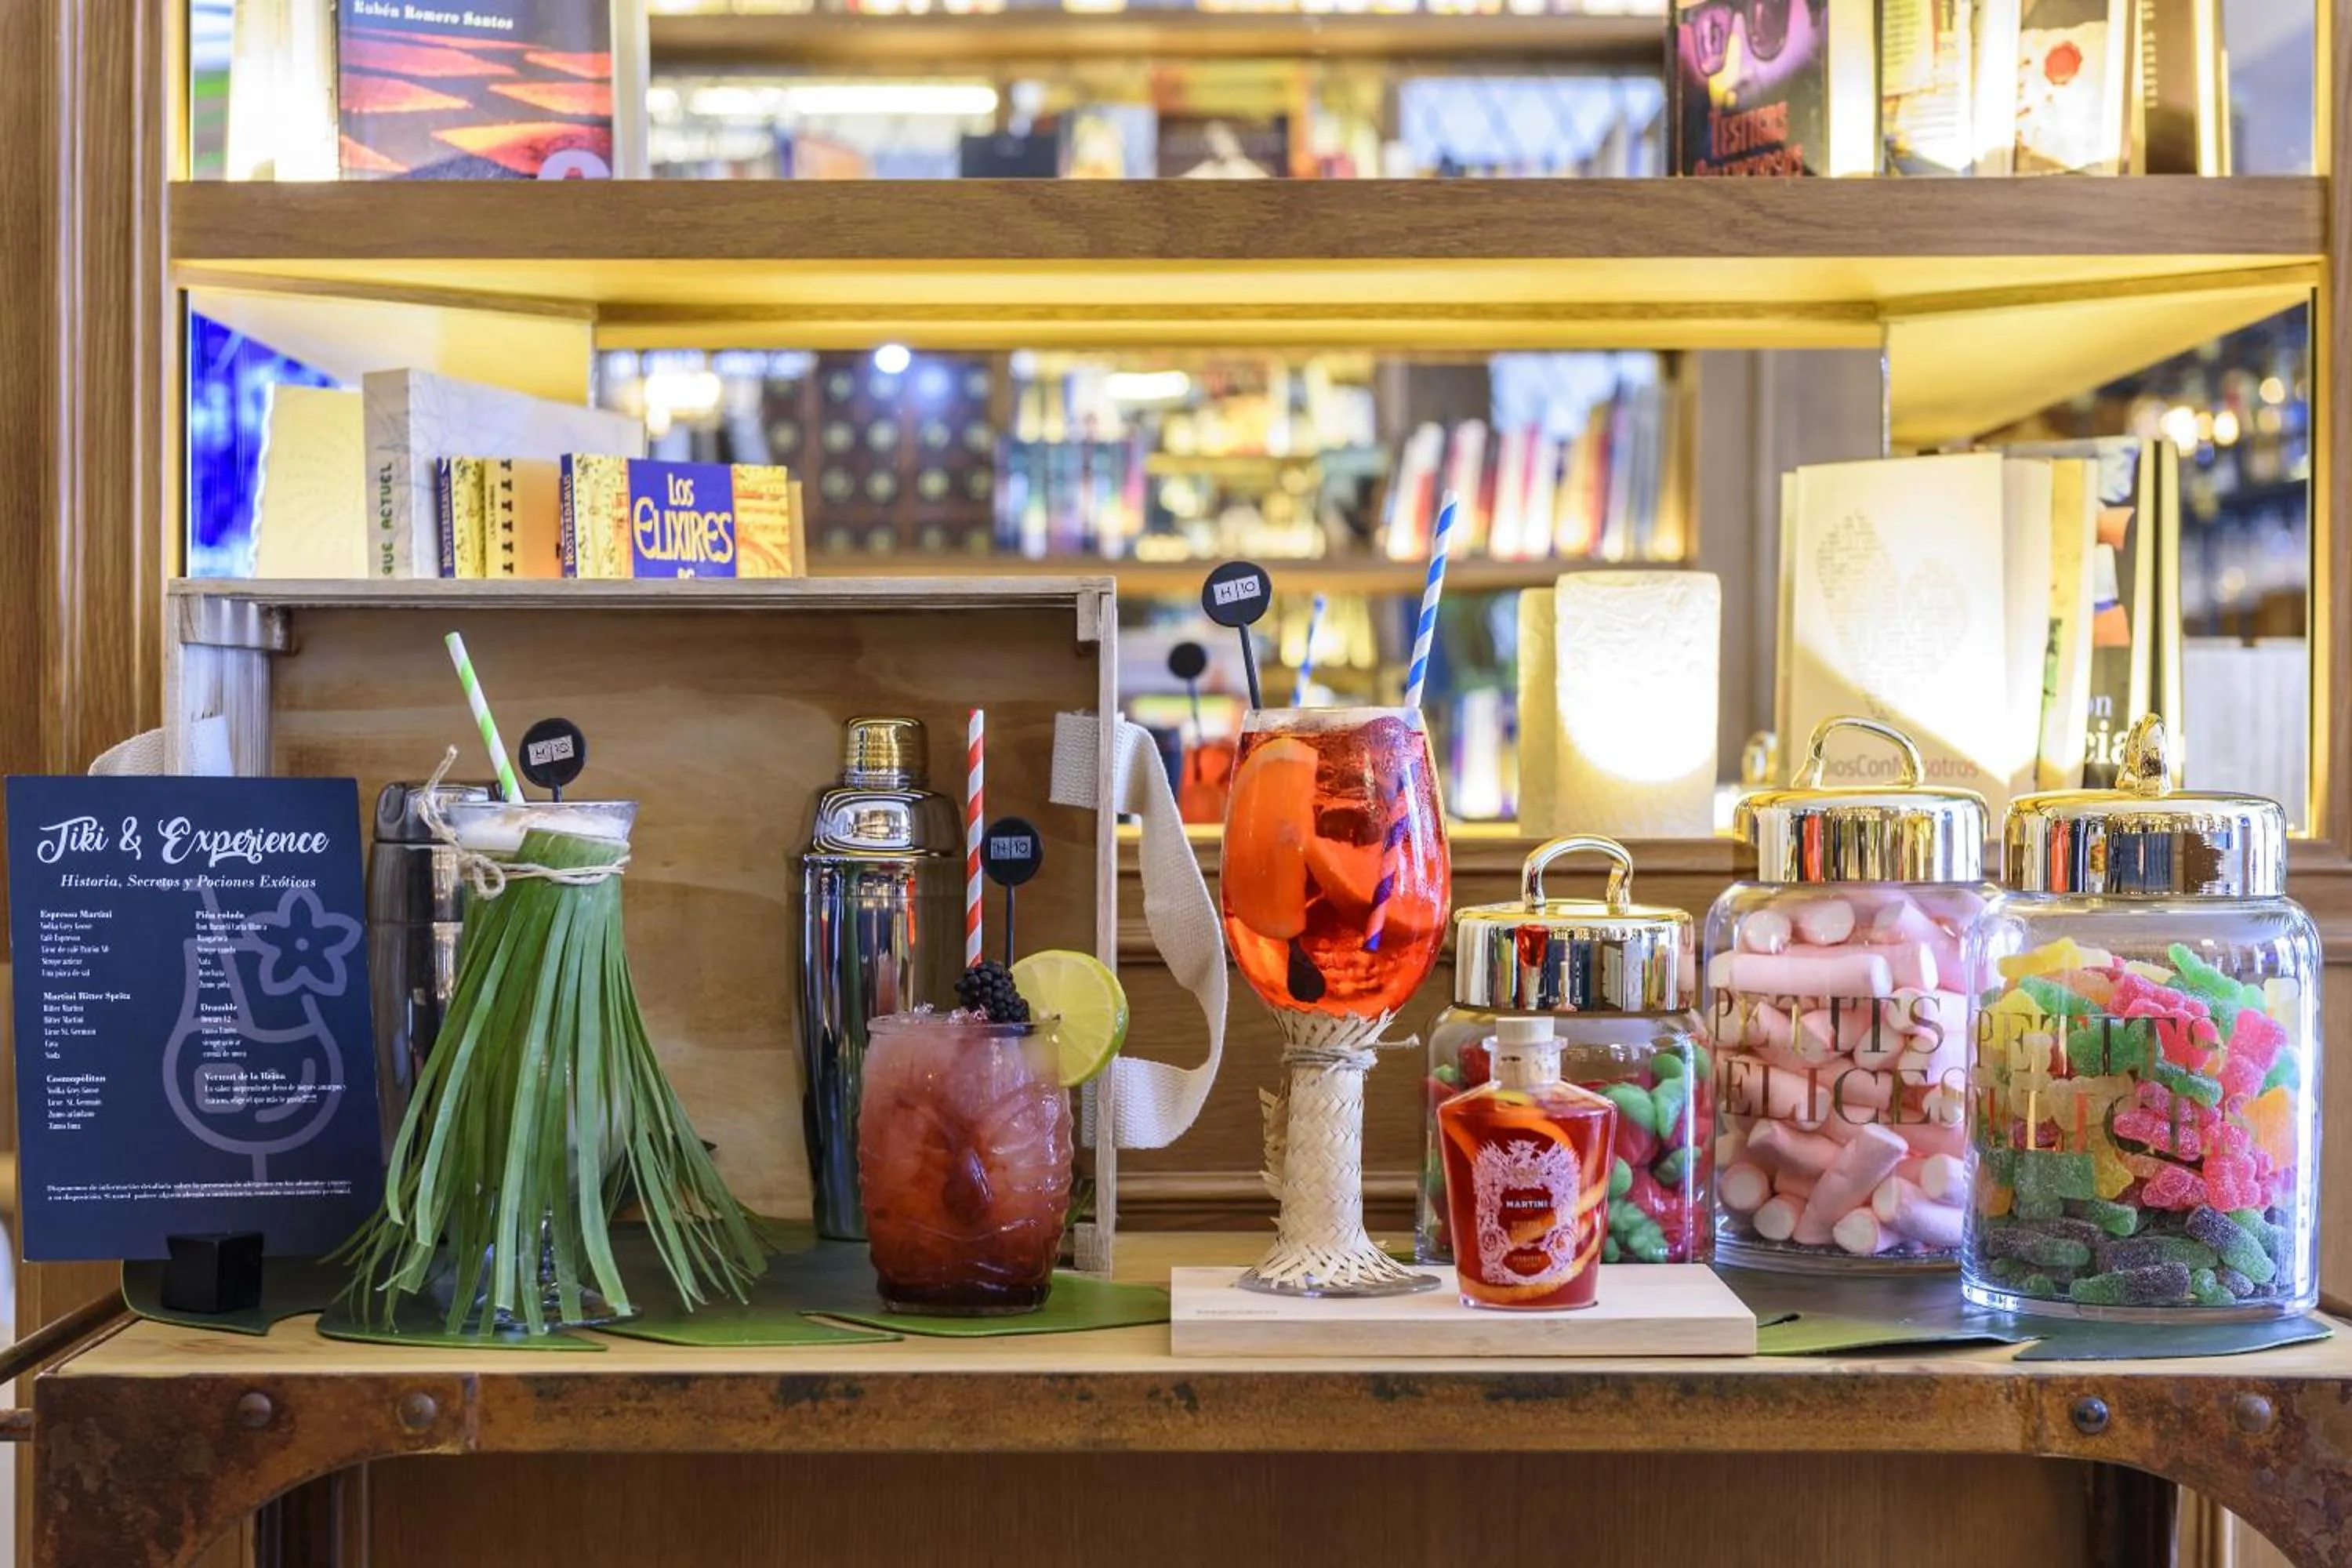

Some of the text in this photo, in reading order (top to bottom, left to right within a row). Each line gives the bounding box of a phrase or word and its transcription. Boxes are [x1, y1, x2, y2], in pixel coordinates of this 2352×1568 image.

[354, 1, 514, 30] Rubén Romero Santos
[380, 462, 392, 530] ACTUEL
[37, 815, 329, 868] Tiki & Experience
[60, 873, 317, 891] Historia, Secretos y Pociones Exóticas
[43, 992, 76, 1000] Martini
[1714, 988, 1945, 1054] PETITS
[1715, 1058, 1965, 1127] ELICES
[1506, 1199, 1548, 1208] MARTINI
